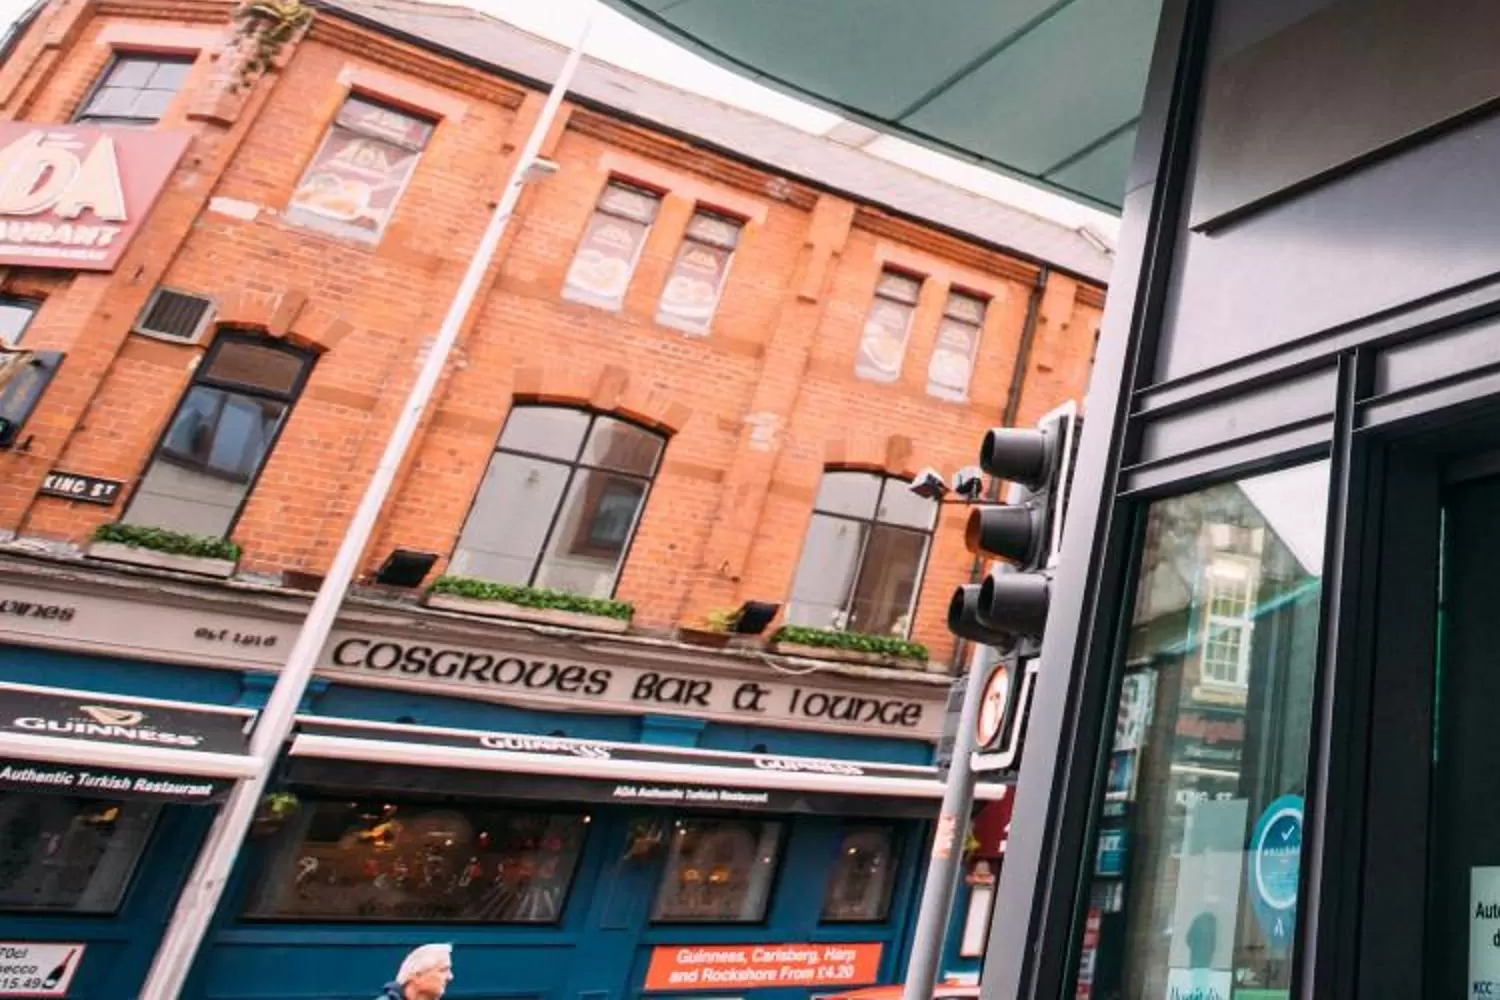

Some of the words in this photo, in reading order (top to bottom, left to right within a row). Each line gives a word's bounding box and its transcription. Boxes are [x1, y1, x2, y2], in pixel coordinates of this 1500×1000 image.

[43, 474, 86, 493] KING
[90, 483, 116, 497] ST
[13, 716, 200, 747] GUINNESS
[0, 765, 74, 785] Authentic
[77, 773, 132, 790] Turkish
[133, 778, 214, 796] Restaurant
[669, 968, 699, 983] and
[778, 964, 815, 980] From
